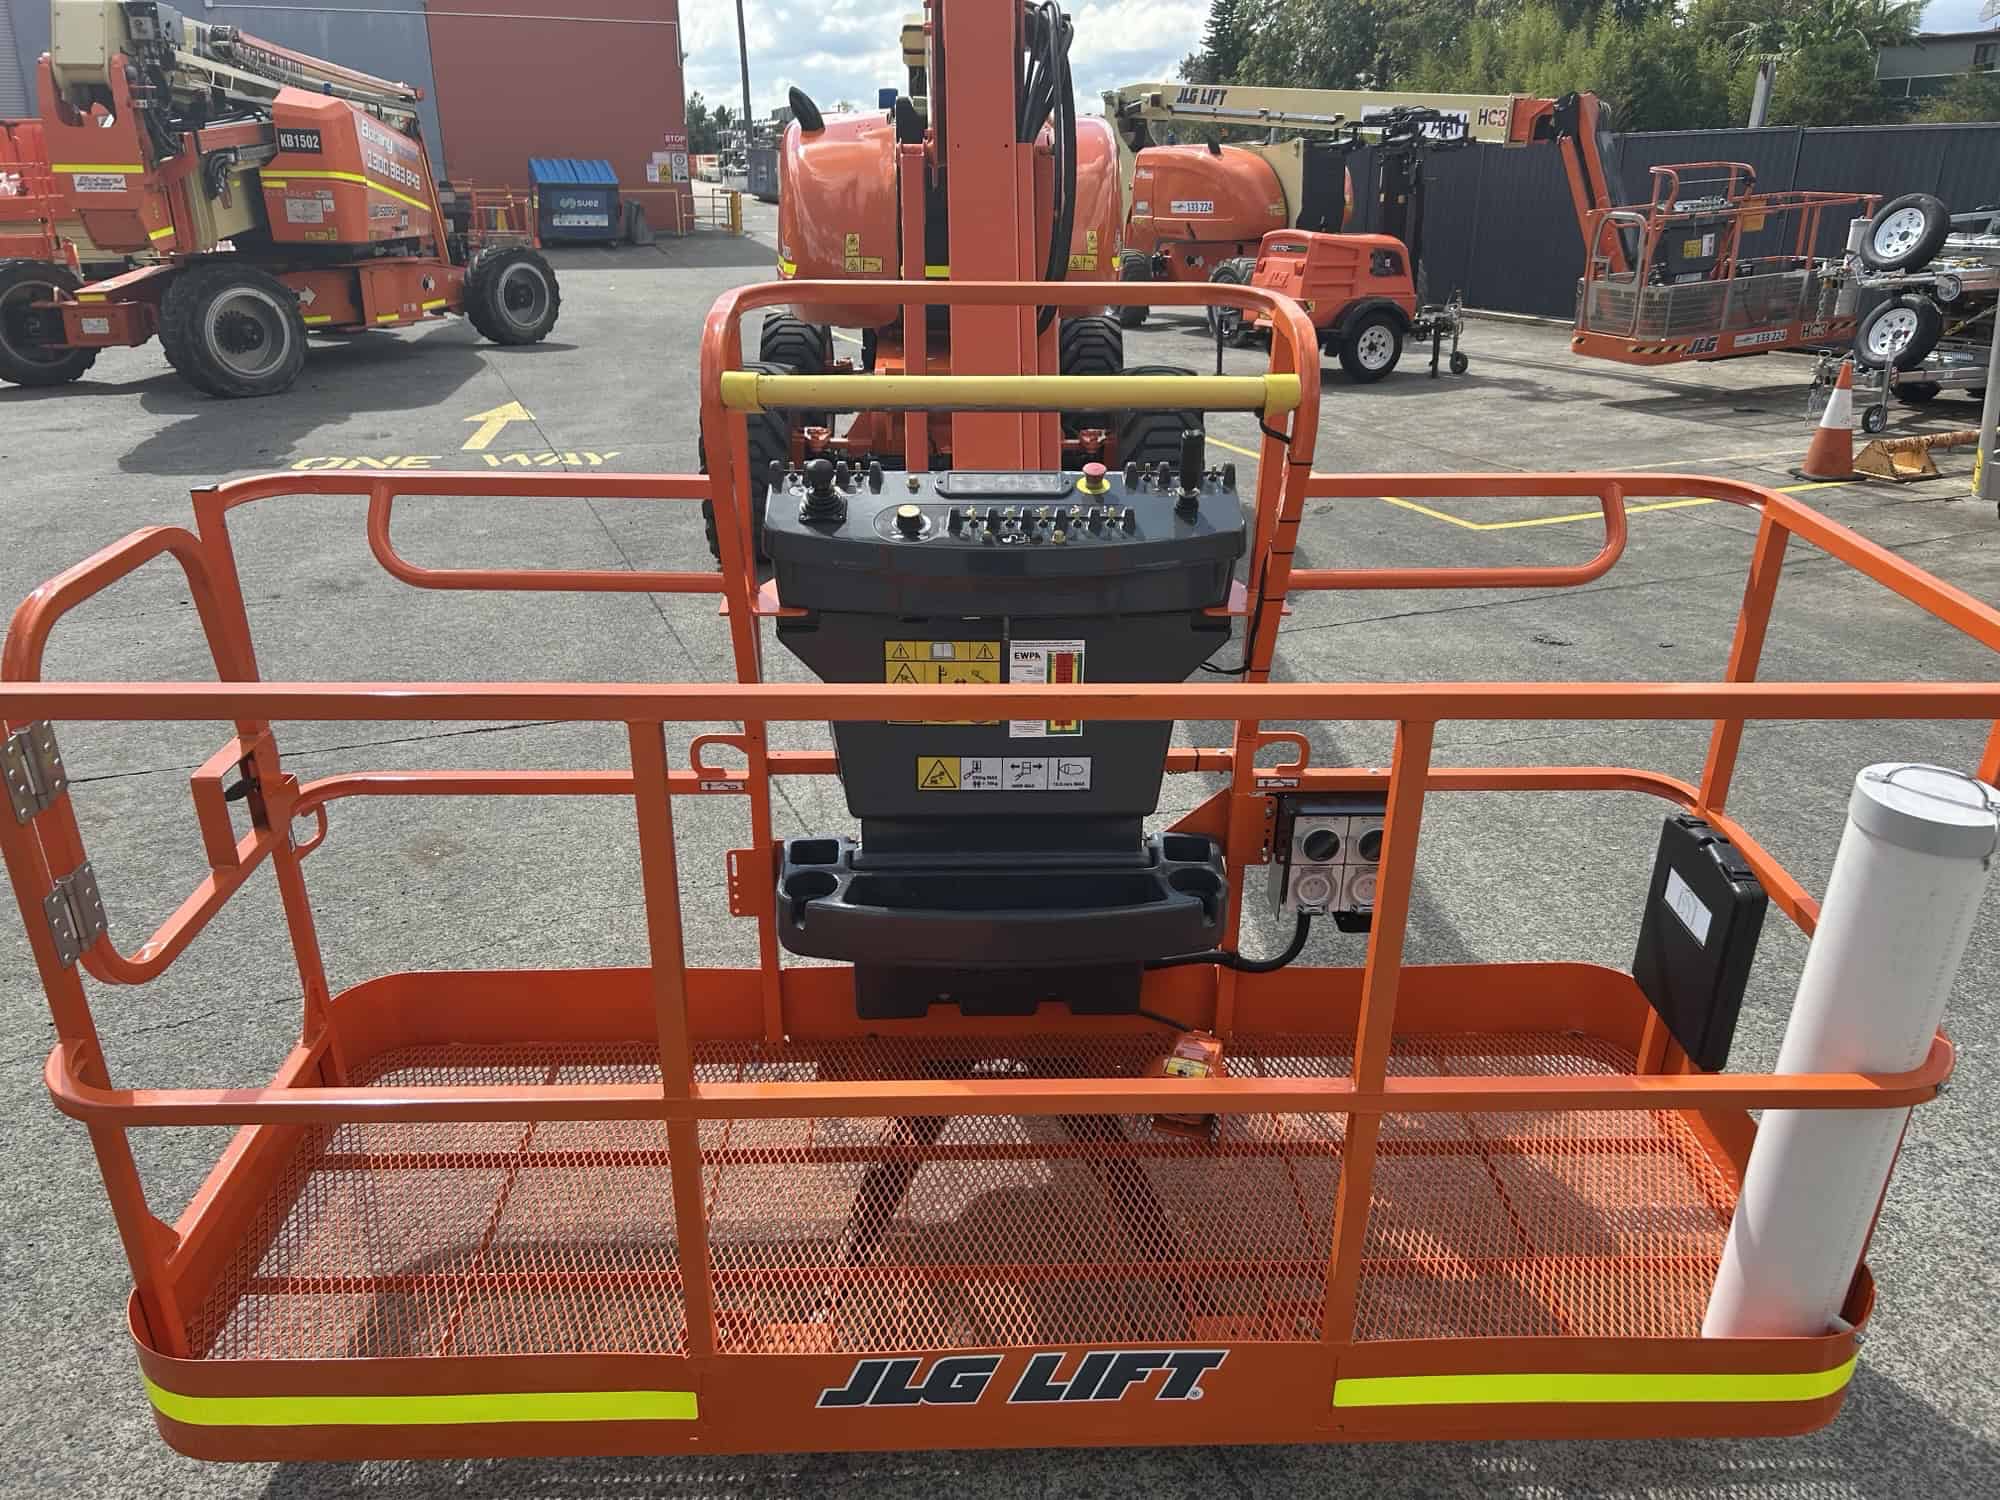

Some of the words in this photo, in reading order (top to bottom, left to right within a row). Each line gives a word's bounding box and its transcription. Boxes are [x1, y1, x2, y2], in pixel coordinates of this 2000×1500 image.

[1176, 87, 1199, 104] JLG
[1200, 87, 1227, 106] LIFT
[1478, 108, 1507, 127] HC3
[280, 133, 319, 149] KB1502
[1187, 201, 1199, 211] 133
[1200, 202, 1212, 211] 224
[1686, 336, 1719, 355] JLG
[291, 455, 442, 469] ONE
[482, 452, 621, 467] WAY
[1014, 651, 1041, 660] EWPA
[816, 1355, 1004, 1408] JLG
[1007, 1350, 1230, 1404] LIFT
